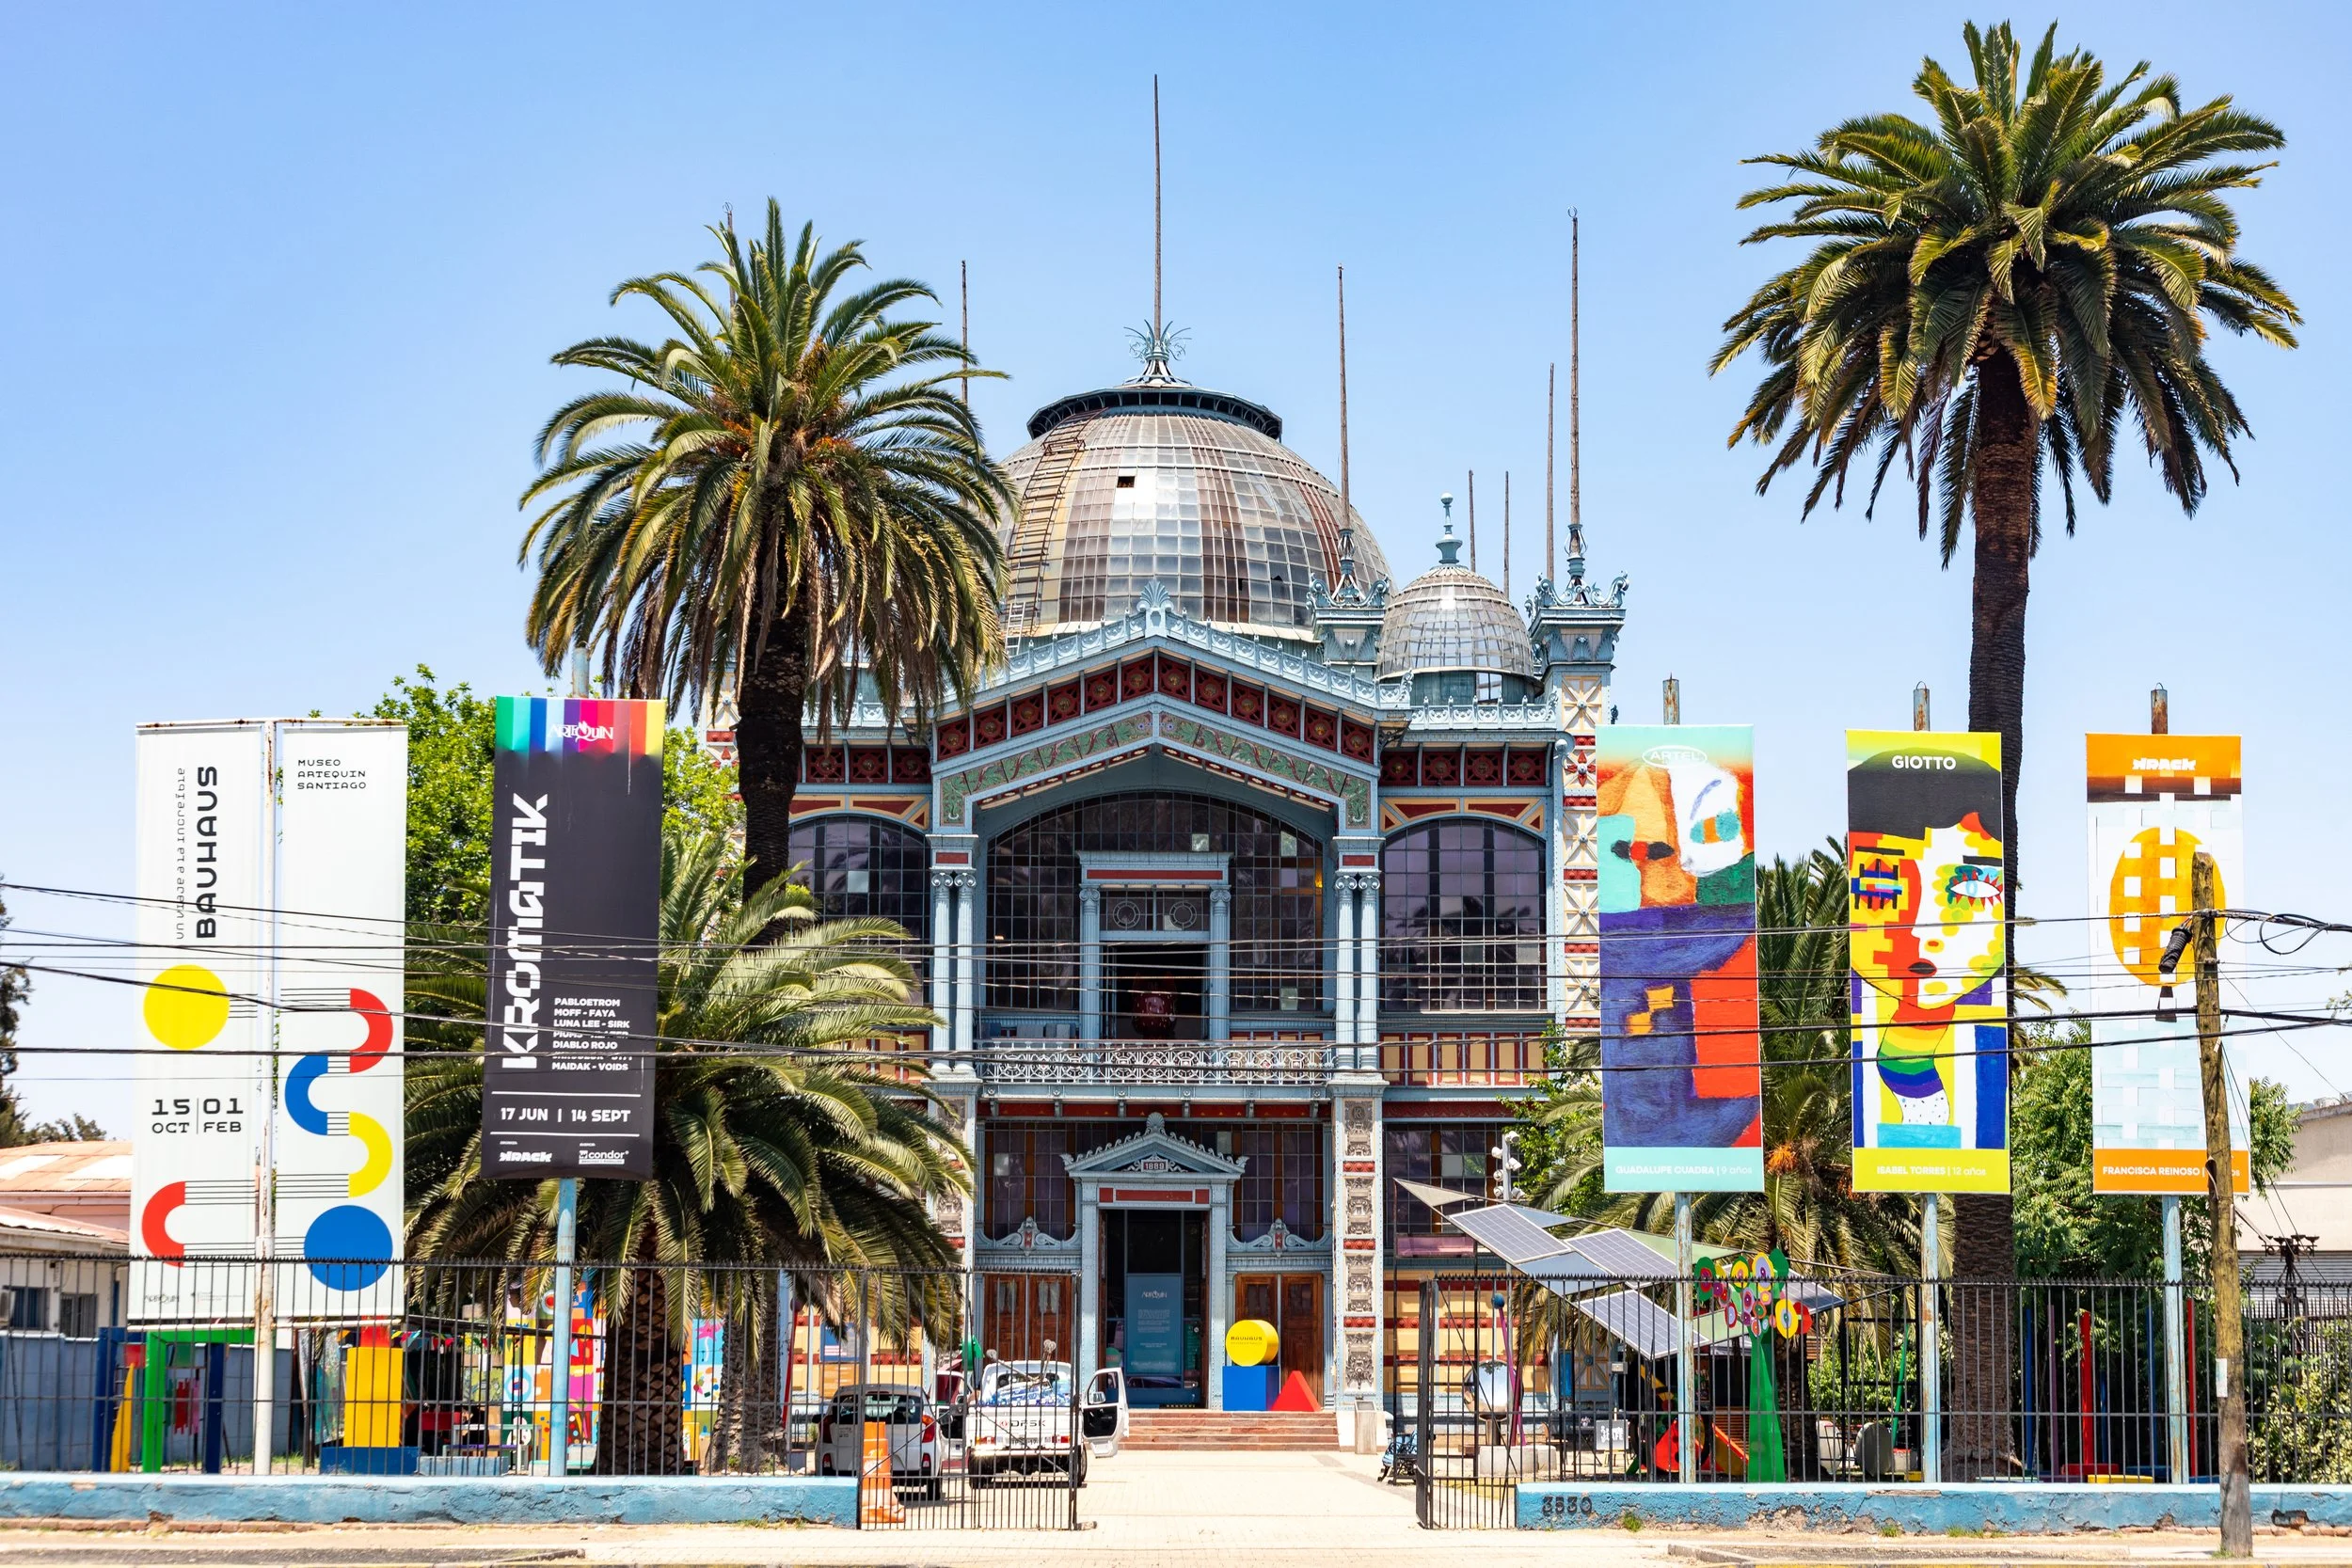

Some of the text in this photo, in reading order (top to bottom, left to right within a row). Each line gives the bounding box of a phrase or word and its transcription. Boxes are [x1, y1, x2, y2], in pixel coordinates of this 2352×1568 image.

[1649, 751, 1701, 761] ARTEL
[1891, 754, 1957, 770] GIOTTO
[297, 770, 366, 779] ARTEQUIN
[297, 782, 367, 790] SANTIAGO
[177, 847, 184, 862] la
[196, 767, 217, 938] BAUHAUS
[554, 998, 620, 1007] PABLOETROM
[553, 1008, 581, 1017] MOFF
[589, 1009, 616, 1018] FAYA
[553, 1019, 580, 1027] LUNA
[552, 1040, 618, 1050] DIABLO ROJO
[551, 1062, 591, 1070] MAIDAK
[598, 1063, 629, 1071] VOIDS
[151, 1098, 244, 1116] 15 01
[501, 1107, 516, 1120] 17
[518, 1108, 548, 1121] JUN
[571, 1109, 587, 1122] 14
[591, 1109, 631, 1122] SEPT
[151, 1121, 242, 1133] OCT FEB
[1614, 1165, 1673, 1175] GUADALUPE
[1674, 1165, 1715, 1175] CUADRA
[1721, 1165, 1727, 1175] 9
[1729, 1165, 1753, 1175] años
[1876, 1165, 1908, 1175] ISABEL
[1910, 1165, 1947, 1175] TORRES
[1953, 1166, 1962, 1175] 12
[2103, 1165, 2156, 1176] FRANCISCA
[2158, 1166, 2201, 1176] REINOSO
[1542, 1496, 1593, 1515] 3530
